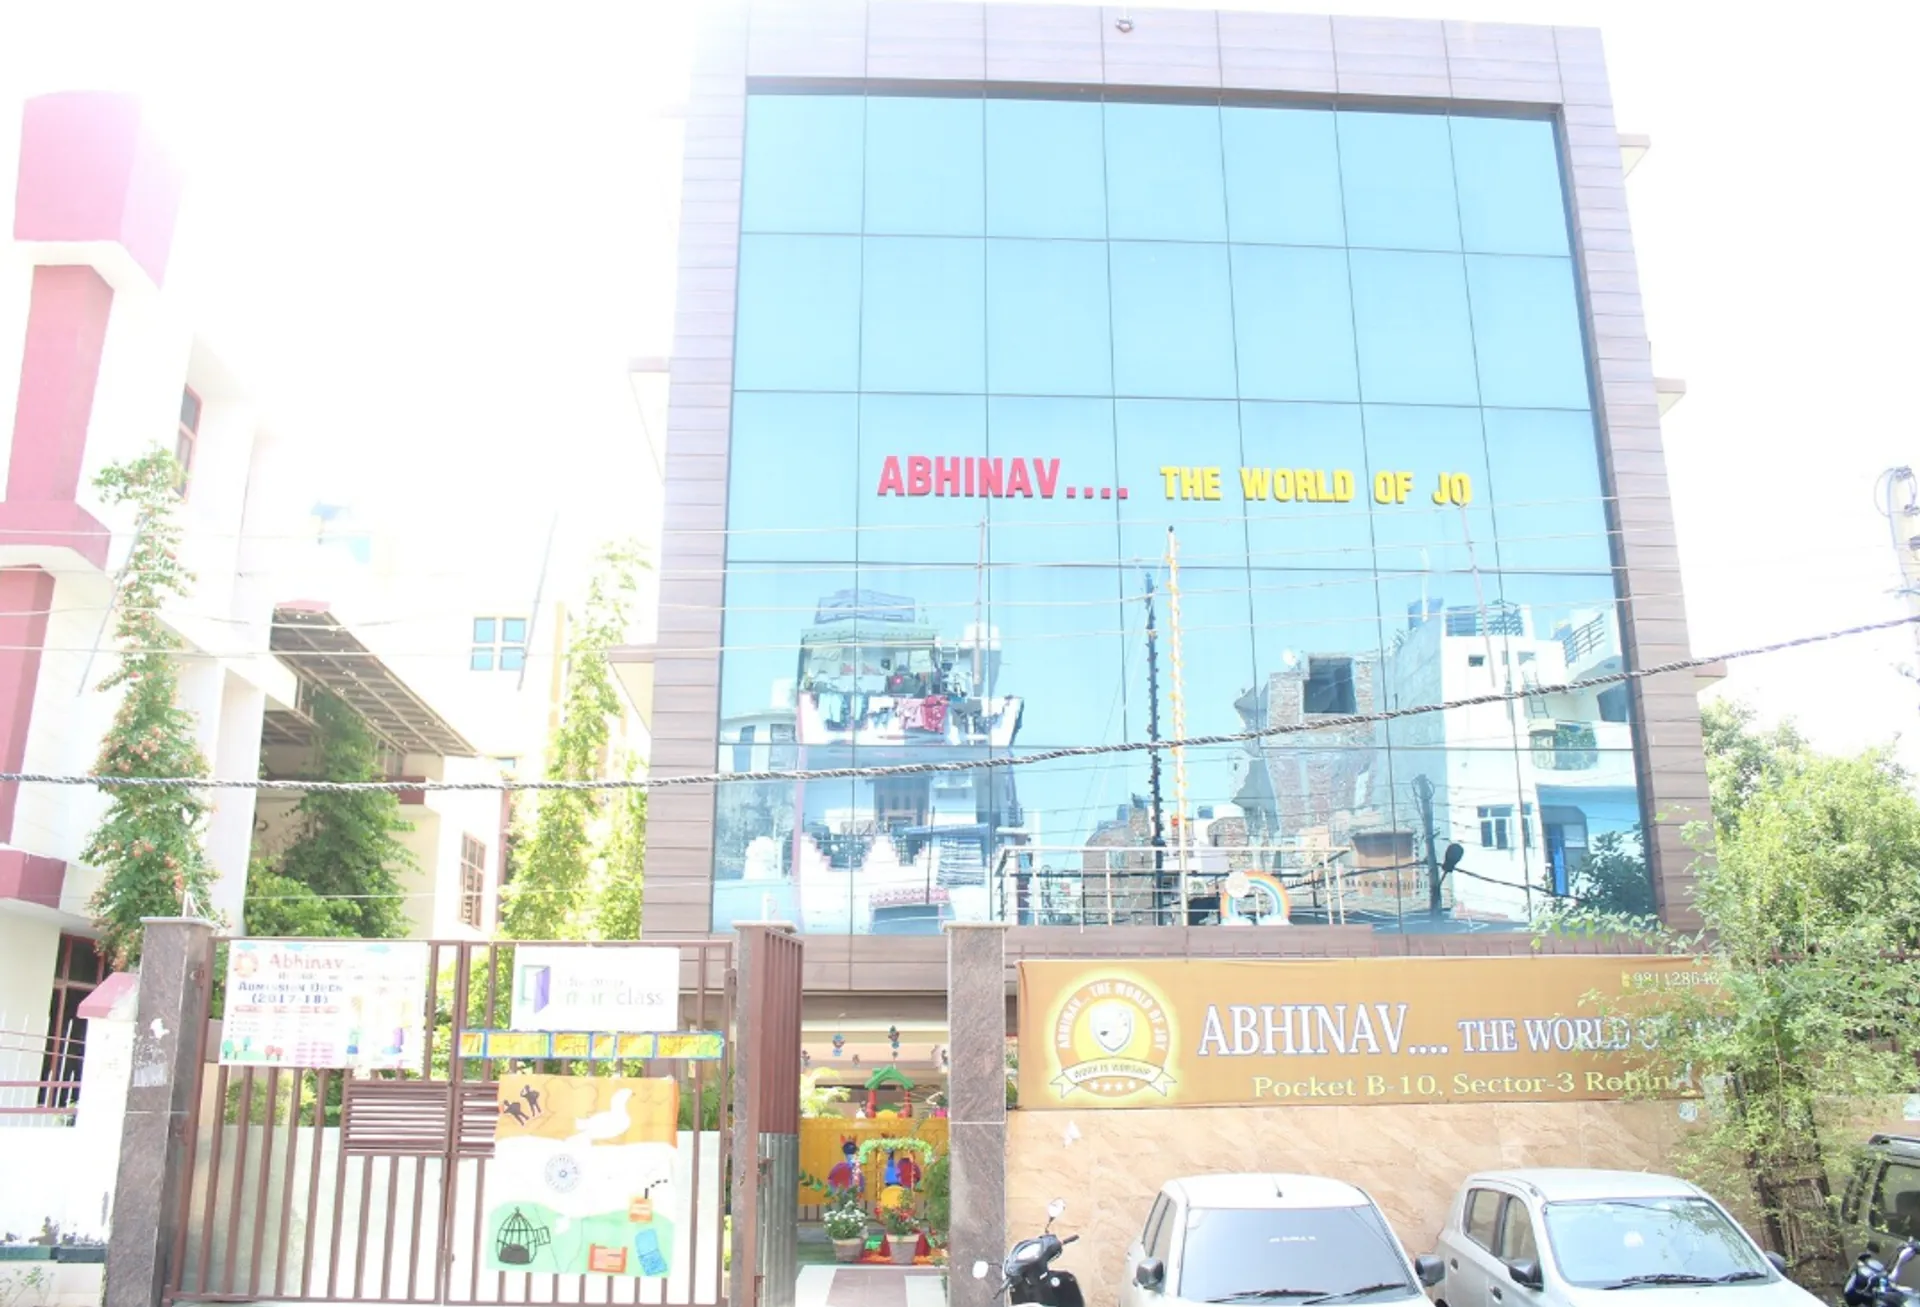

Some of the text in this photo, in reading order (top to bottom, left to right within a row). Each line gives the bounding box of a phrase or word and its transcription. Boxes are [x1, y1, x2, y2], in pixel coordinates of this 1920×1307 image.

[1160, 465, 1222, 501] THE
[1241, 467, 1355, 504] WORLD
[1374, 469, 1414, 504] OF
[1433, 472, 1472, 506] JO
[1458, 1018, 1519, 1053] THE
[1523, 1017, 1631, 1051] WORLD
[1252, 1075, 1357, 1098] Pocket
[1453, 1070, 1575, 1095] Sector-3
